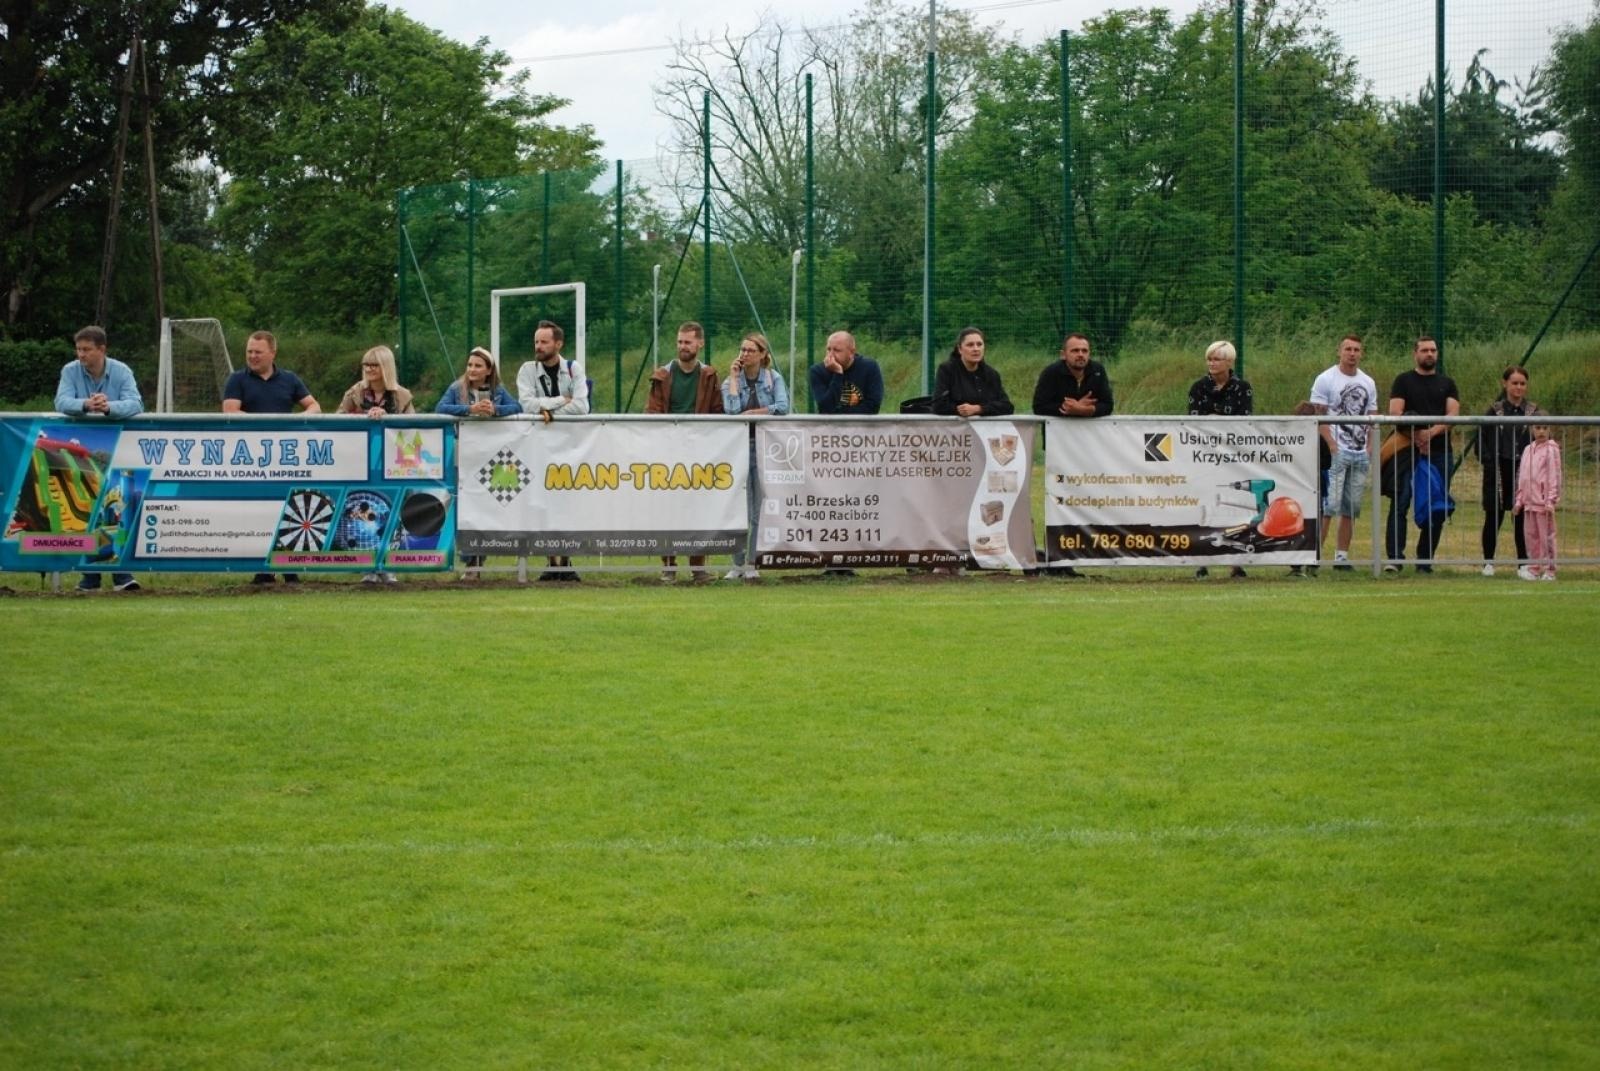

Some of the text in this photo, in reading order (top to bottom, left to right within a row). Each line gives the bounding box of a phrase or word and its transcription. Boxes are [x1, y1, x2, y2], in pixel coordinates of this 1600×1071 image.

[810, 434, 973, 449] PERSONALIZOWANE
[1179, 432, 1305, 448] Usługi Remontowe
[138, 438, 335, 468] WYNAJEM
[811, 450, 972, 464] PROJEKTY ZE SKLEJEK
[1192, 450, 1294, 466] Krzysztof Kaim
[163, 469, 212, 479] ATRAKCJI
[214, 469, 229, 479] NA
[231, 469, 267, 480] UDANĄ
[544, 462, 734, 491] MAN-TRANS
[812, 466, 973, 479] WYCINANE LASEREM CO2
[1066, 473, 1187, 486] wykończenia wnętrz
[785, 494, 880, 507] ul. Brzeska 69
[1138, 495, 1199, 509] budynków
[145, 504, 181, 512] KONTAKT:
[785, 509, 880, 521] 47-400 Racibórz
[786, 528, 881, 542] 501 243 111
[1059, 533, 1191, 549] tel. 782 680 799
[561, 539, 582, 550] Tychy
[647, 539, 657, 548] 70
[671, 538, 736, 548] www.mantrans.pl
[775, 554, 823, 565] e-fraim.pl
[846, 554, 899, 563] 501 243 111
